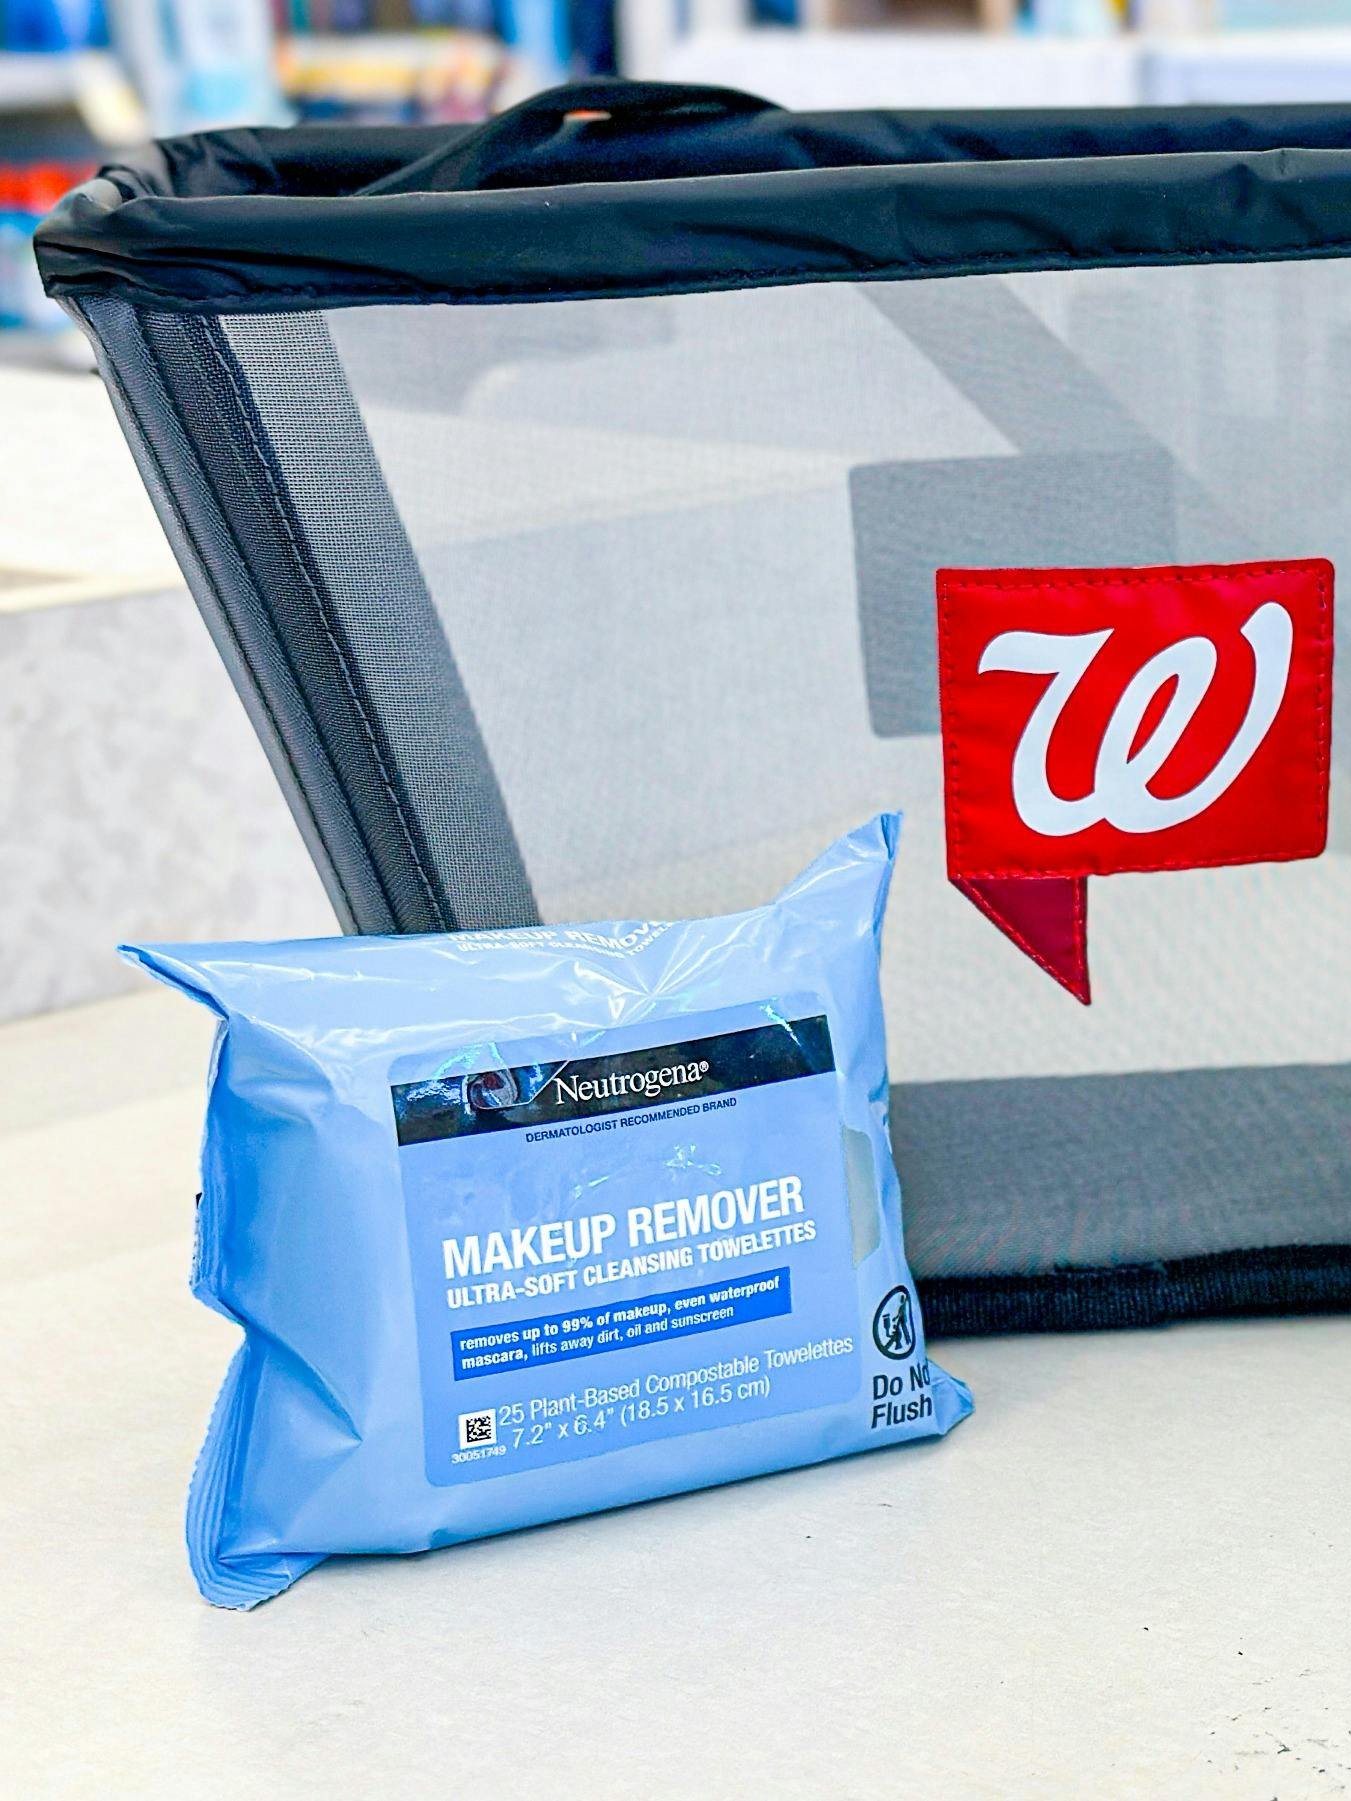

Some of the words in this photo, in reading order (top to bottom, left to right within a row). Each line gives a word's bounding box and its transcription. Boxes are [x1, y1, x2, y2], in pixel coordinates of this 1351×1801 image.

[450, 931, 558, 941] MAKEUP
[553, 1060, 709, 1105] Neutrogena®
[525, 1119, 618, 1143] DERMATOLOGIST
[620, 1105, 701, 1127] RECOMMENDED
[702, 1097, 737, 1113] BRAND
[442, 1213, 617, 1280] MAKEUP
[627, 1176, 804, 1248] REMOVER
[447, 1269, 578, 1309] ULTRA-SOFT
[583, 1245, 693, 1288] CLEANSING
[697, 1220, 817, 1264] TOWELETTES
[460, 1330, 520, 1351] removes
[523, 1327, 542, 1342] up
[544, 1324, 558, 1337] to
[562, 1316, 593, 1333] 99%
[596, 1312, 610, 1327] of
[613, 1302, 672, 1326] makeup,
[674, 1293, 706, 1311] even
[709, 1276, 781, 1304] waterproof
[461, 1349, 529, 1370] mascara,
[532, 1340, 557, 1357] lifts
[560, 1336, 594, 1352] away
[597, 1328, 623, 1344] dirt,
[627, 1324, 642, 1338] oil
[644, 1318, 668, 1334] and
[671, 1306, 734, 1330] sunscreen
[500, 1403, 525, 1427] 25
[530, 1376, 641, 1421] Plant-Based
[645, 1353, 760, 1398] Compostable
[763, 1335, 854, 1370] Towelettes
[558, 1423, 569, 1439] x
[620, 1396, 669, 1429] (18.5
[673, 1395, 685, 1412] x
[692, 1383, 733, 1410] 16.5
[737, 1376, 772, 1400] cm)
[871, 1394, 932, 1429] Flush
[873, 1374, 903, 1400] Do
[910, 1362, 931, 1391] No
